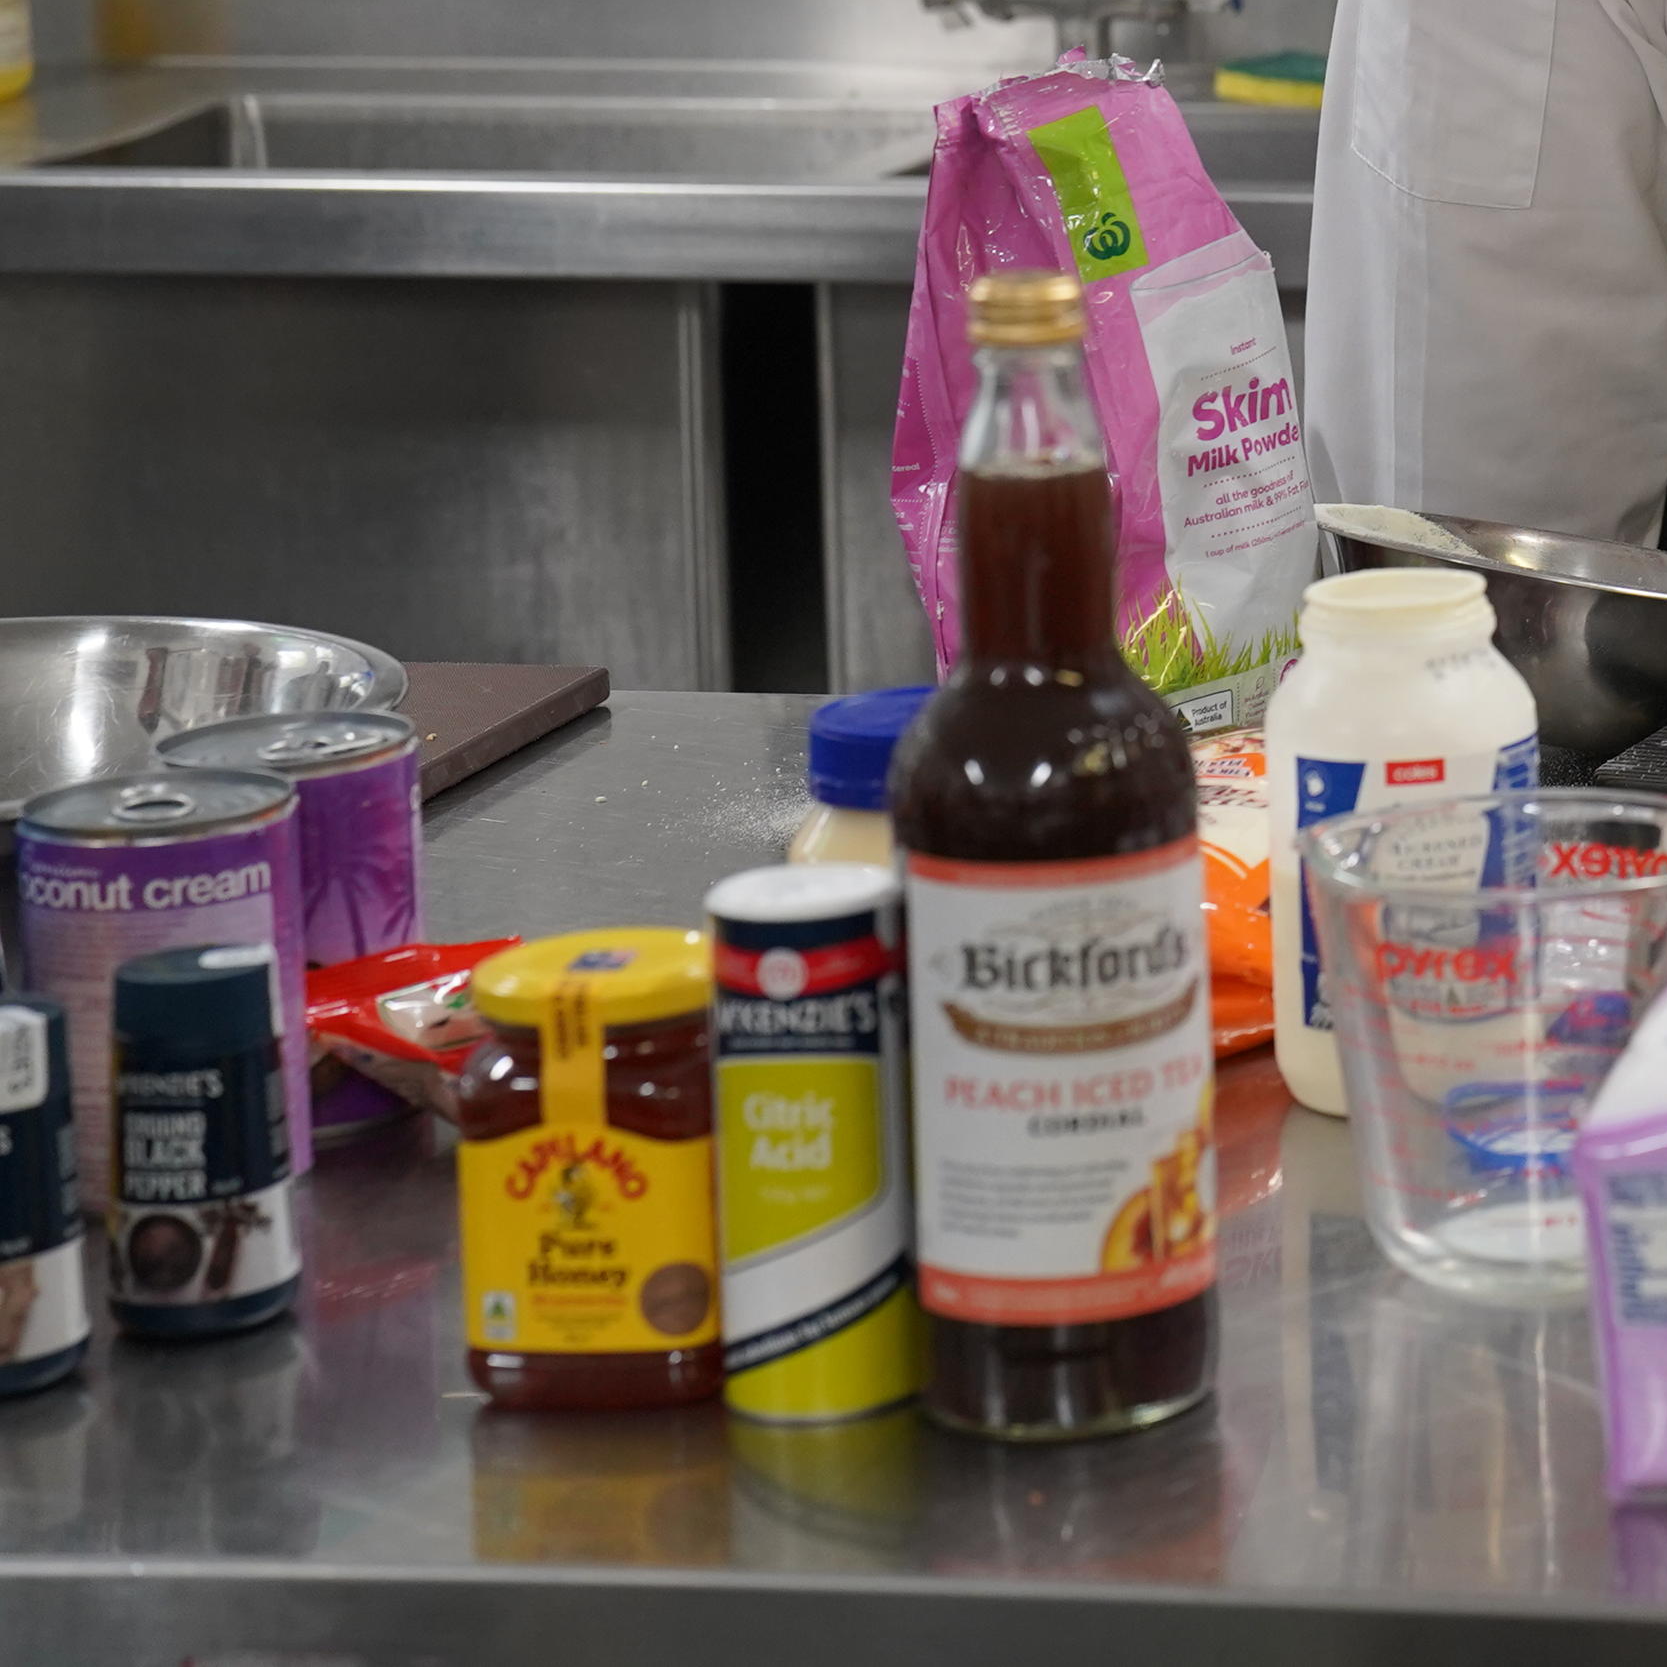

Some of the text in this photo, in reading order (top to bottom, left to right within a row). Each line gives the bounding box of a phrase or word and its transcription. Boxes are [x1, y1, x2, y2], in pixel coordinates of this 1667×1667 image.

[1230, 337, 1257, 355] Instant
[1192, 376, 1293, 441] Skim
[1187, 422, 1299, 477] Milk Powde
[1184, 504, 1243, 528] Australian
[1243, 499, 1265, 514] milk
[1266, 494, 1275, 506] &
[1216, 492, 1231, 506] all
[1232, 488, 1249, 503] the
[1250, 474, 1287, 499] goodness
[1192, 700, 1227, 717] Product of
[142, 861, 273, 910] cream
[1375, 941, 1517, 986] pyrex
[943, 1073, 1062, 1113] PEACH
[1071, 1066, 1154, 1109] ICED
[743, 1091, 838, 1136] Citric
[749, 1132, 834, 1174] Acid
[538, 1232, 618, 1262] Pure
[526, 1259, 632, 1291] Honey
